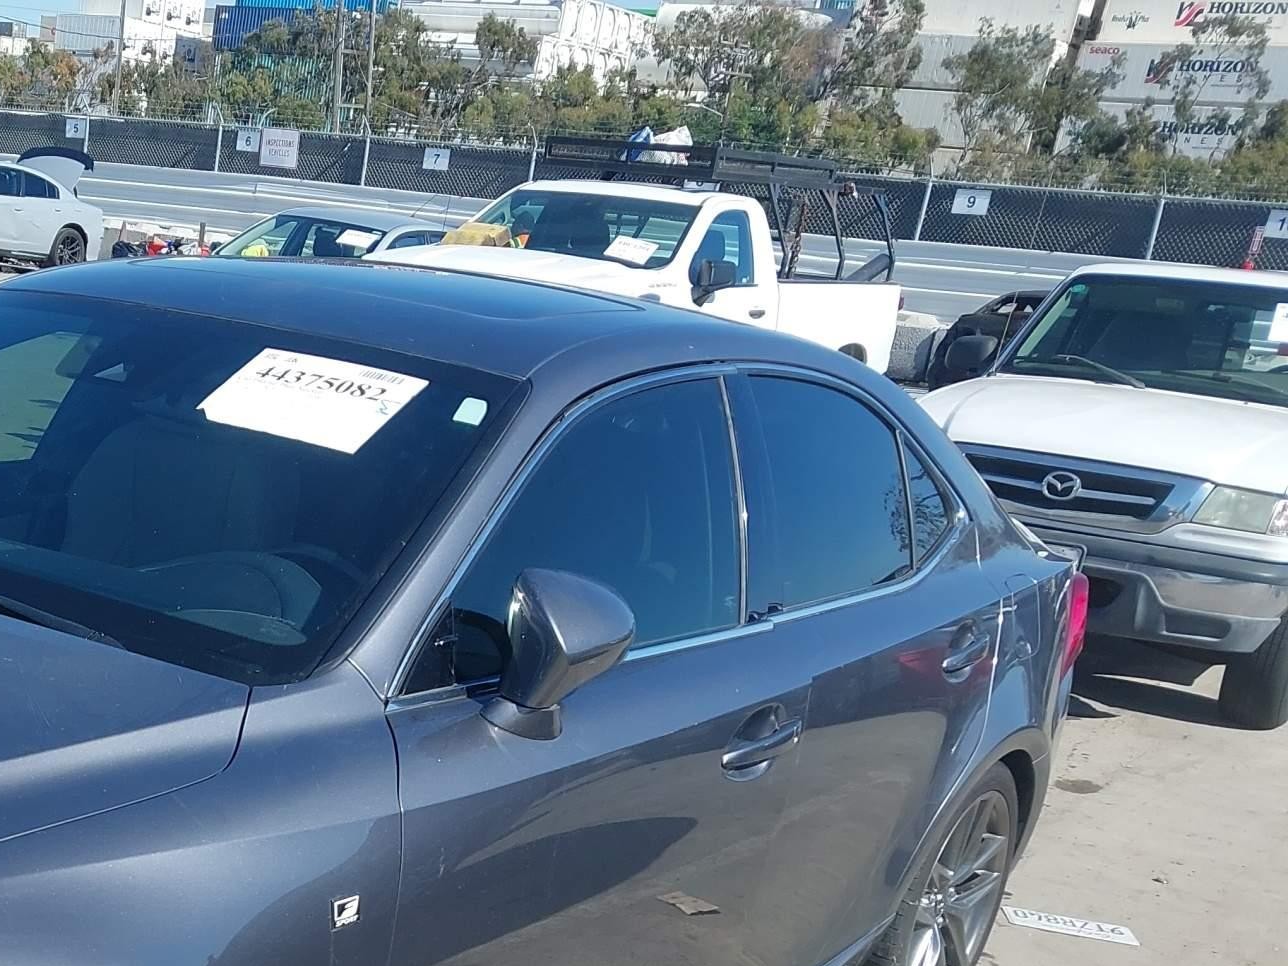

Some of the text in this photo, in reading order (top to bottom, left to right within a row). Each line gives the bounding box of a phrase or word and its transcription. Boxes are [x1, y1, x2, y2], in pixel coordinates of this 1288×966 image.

[1207, 2, 1288, 14] HORIZON
[1089, 46, 1120, 55] seaco
[1178, 60, 1258, 72] HORIZON
[73, 123, 79, 133] 5
[245, 136, 252, 146] 6
[434, 153, 441, 165] 7
[967, 195, 977, 208] 9
[255, 365, 388, 401] 44375082
